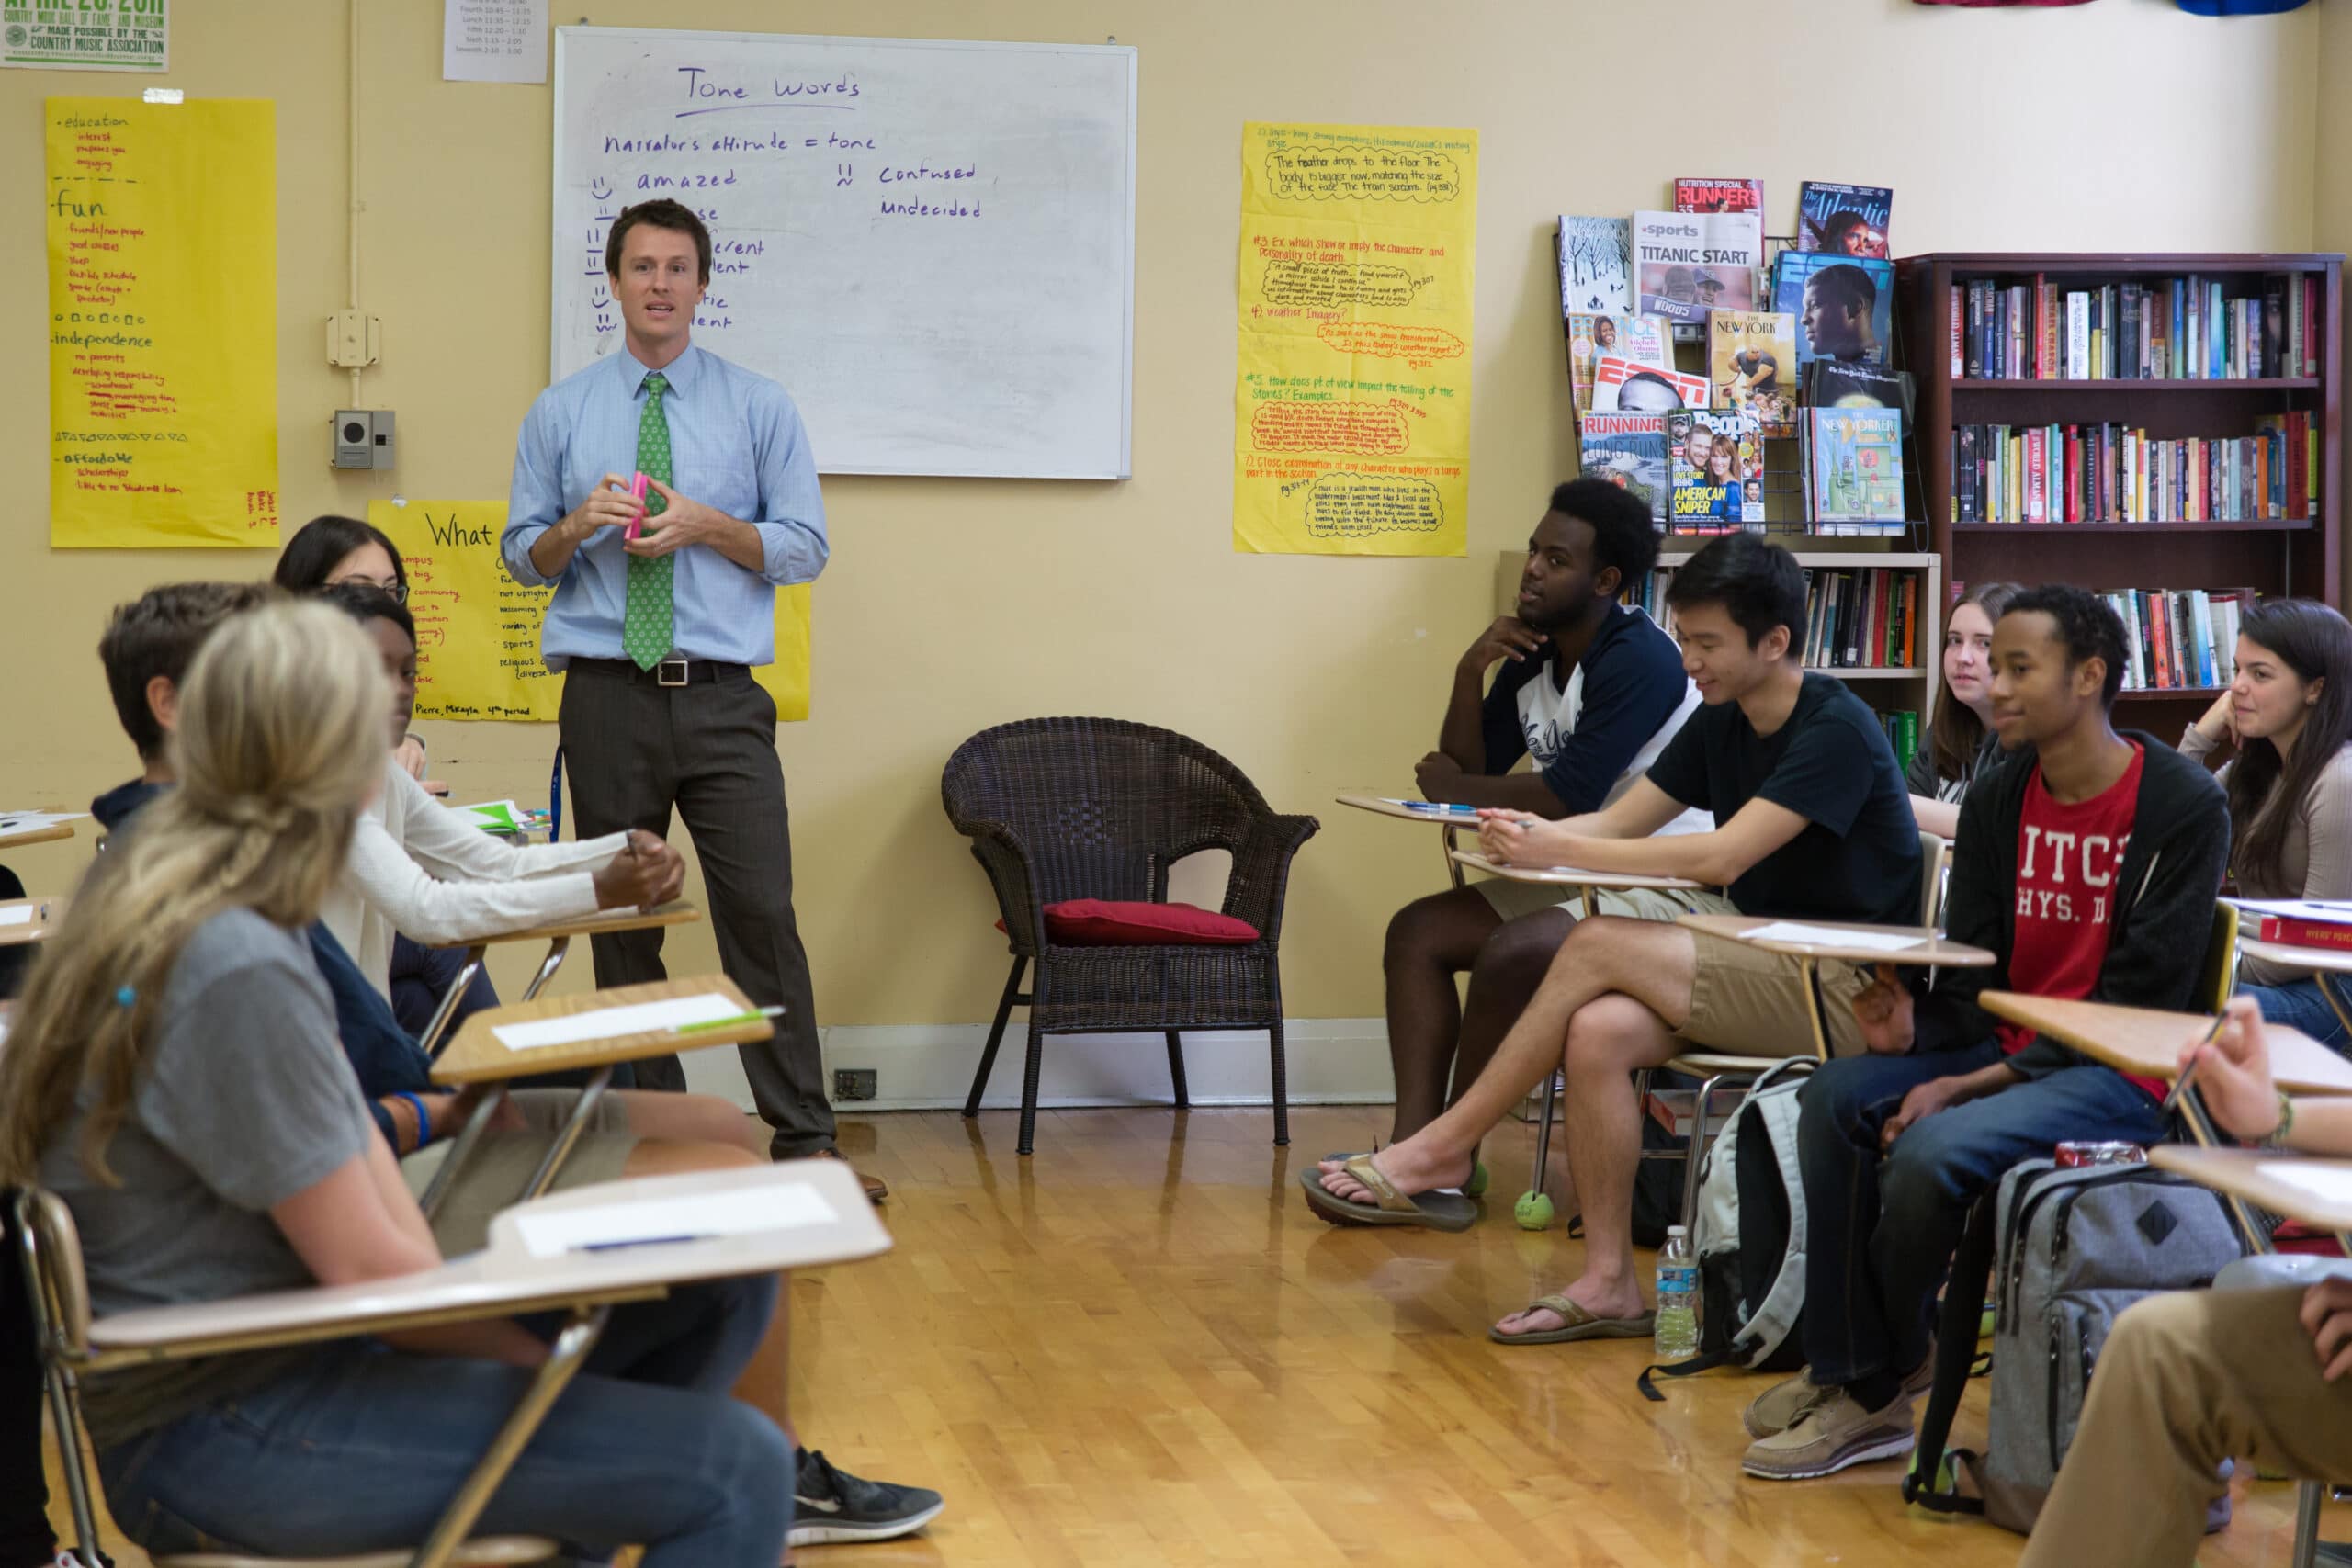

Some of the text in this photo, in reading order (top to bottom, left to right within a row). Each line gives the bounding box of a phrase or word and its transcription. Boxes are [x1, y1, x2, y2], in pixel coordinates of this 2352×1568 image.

[80, 12, 87, 25] OF
[93, 12, 110, 26] FAME
[135, 15, 164, 28] MUSEUM
[48, 26, 147, 39] MADE POSSIBLE BY THE
[31, 37, 164, 54] COUNTRY MUSIC ASSOCIATION
[678, 68, 749, 99] Tone
[65, 110, 129, 127] education
[712, 132, 788, 150] attitude
[828, 132, 876, 150] tone
[1274, 155, 1293, 168] The
[1363, 155, 1374, 166] to
[1380, 153, 1397, 166] the
[1424, 156, 1441, 167] The
[637, 169, 738, 190] amazed
[1279, 170, 1443, 185] body bigger matching the size
[1678, 180, 1743, 189] NUTRITION SPECIAL
[1298, 182, 1314, 193] the
[1343, 182, 1359, 193] The
[1363, 182, 1385, 193] train
[56, 189, 107, 217] fun
[1647, 225, 1698, 238] sports
[1289, 237, 1313, 248] which
[1337, 242, 1347, 250] or
[1349, 241, 1371, 254] imply
[1374, 242, 1386, 252] the
[1429, 246, 1444, 256] and
[1306, 250, 1317, 261] of
[1640, 246, 1749, 265] TITANIC START
[1780, 253, 1891, 290] EN
[1654, 299, 1690, 317] WOODS
[1365, 329, 1376, 339] the
[1572, 316, 1659, 336] ESNCE
[1716, 321, 1742, 334] NEW
[55, 331, 153, 348] independence
[1400, 343, 1427, 353] weather
[1951, 331, 1960, 359] ALMAN
[90, 354, 125, 364] parents
[1269, 376, 1453, 400] How does of view impact the telling of the
[1584, 417, 1663, 434] RUNNING
[1694, 411, 1759, 439] People
[1822, 419, 1849, 431] NEW
[64, 453, 133, 465] affordable
[1587, 441, 1667, 460] LONG RUNS
[1247, 468, 1287, 479] part in the
[1257, 457, 1461, 479] Close examination of any character who plays large
[2032, 442, 2041, 501] WORLD ALMAN
[1674, 487, 1727, 501] AMERICAN
[1675, 501, 1711, 514] SNIPER
[425, 513, 493, 547] What
[503, 640, 534, 651] sports
[500, 659, 535, 671] religious
[504, 707, 530, 716] period
[2021, 825, 2131, 887] ITC
